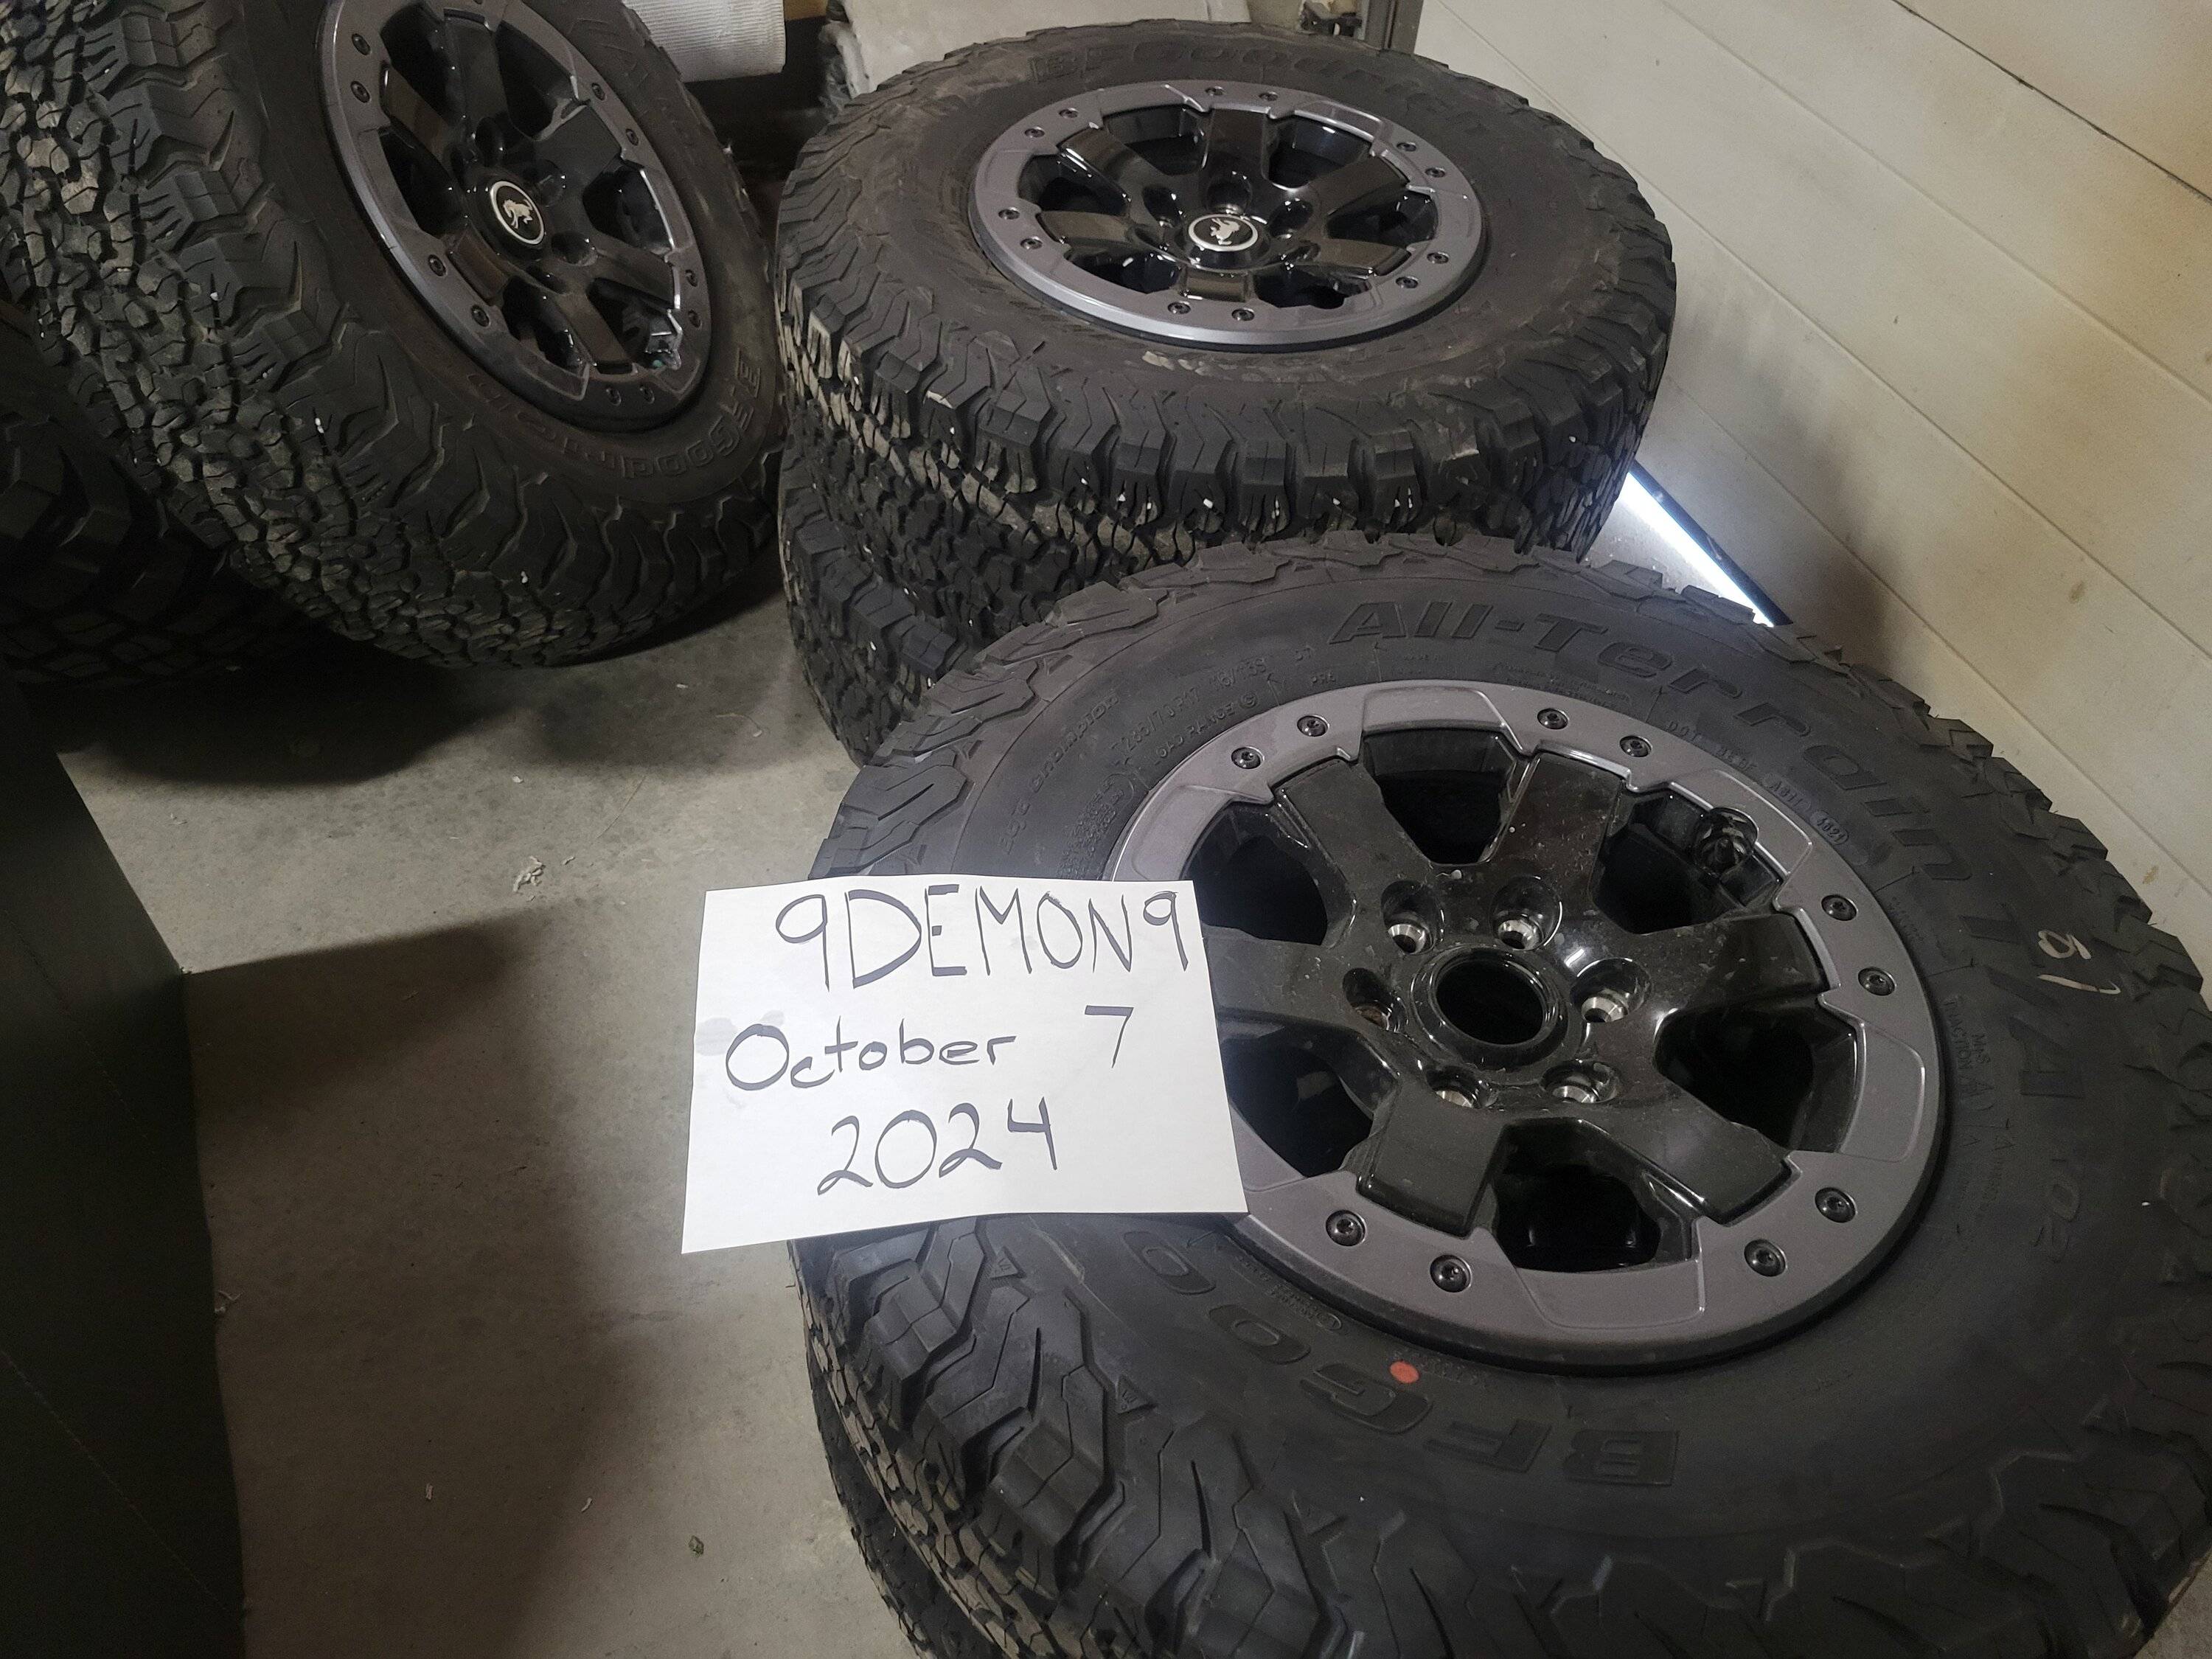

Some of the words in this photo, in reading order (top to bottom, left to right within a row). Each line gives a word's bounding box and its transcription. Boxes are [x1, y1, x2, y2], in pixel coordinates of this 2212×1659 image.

[1328, 600, 1973, 881] All-Terrain
[774, 883, 1189, 992] 9DEMON9
[726, 1015, 1017, 1091] October
[1084, 1005, 1134, 1069] 7
[817, 1097, 1058, 1196] 2024
